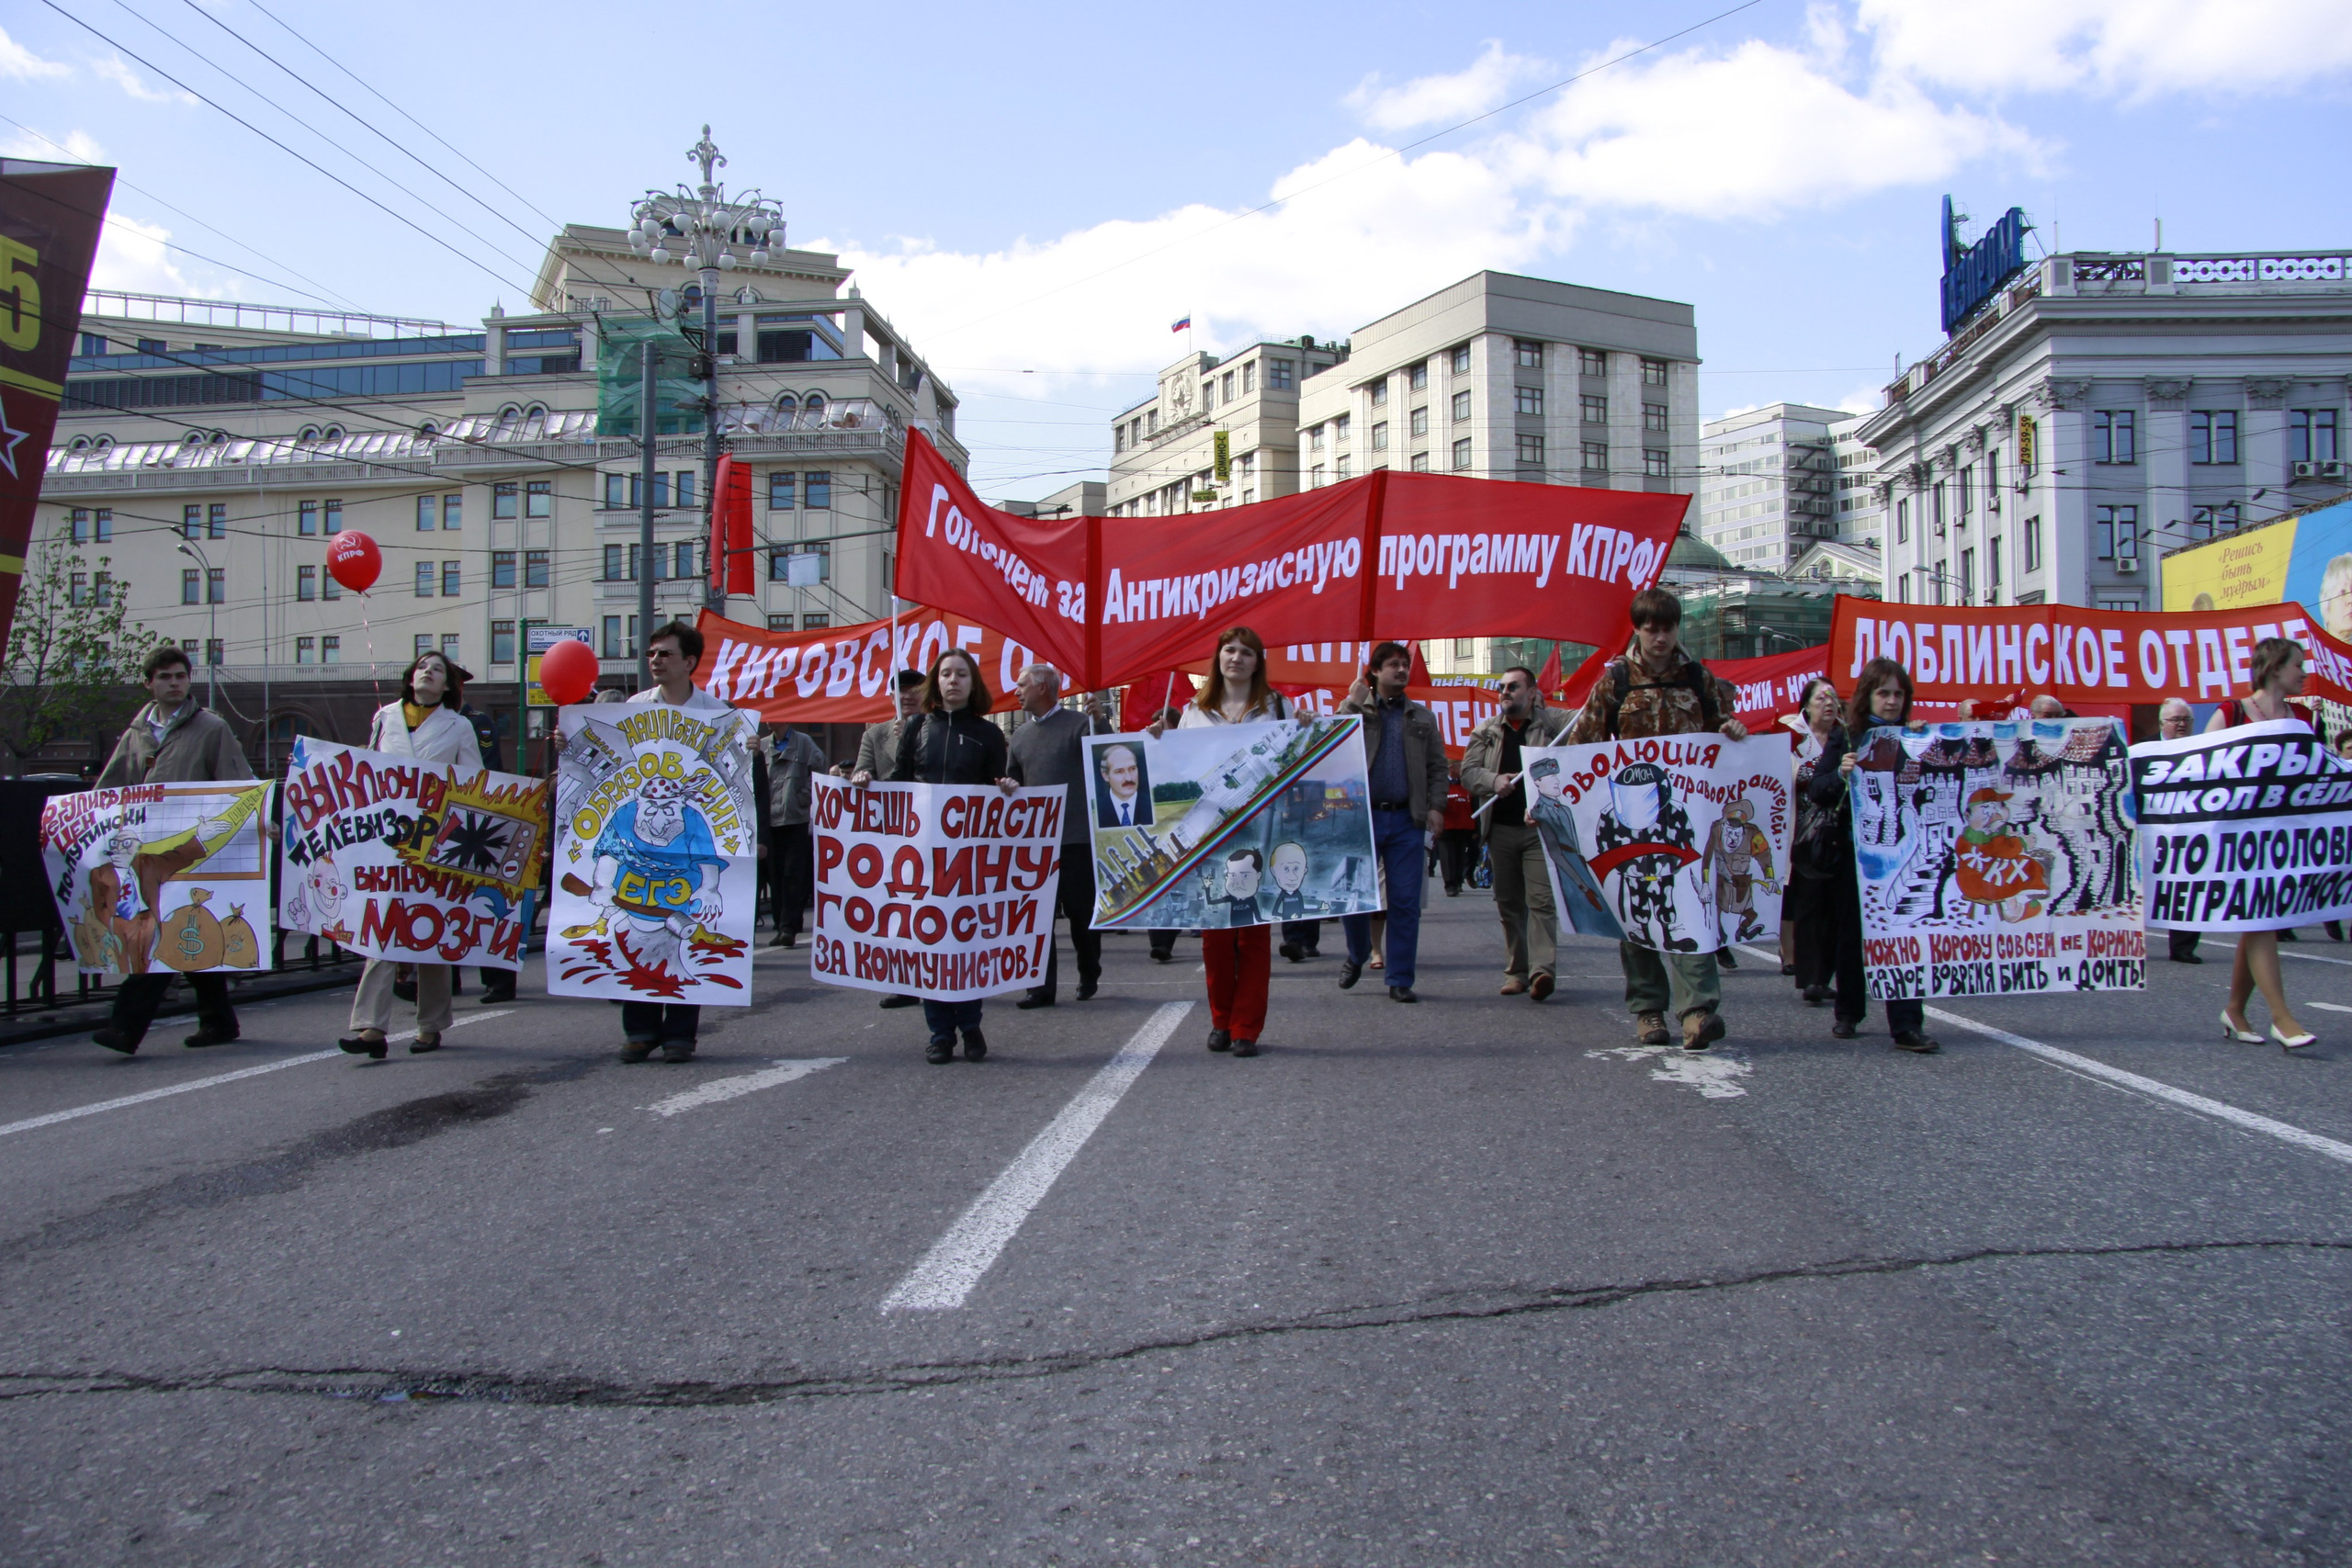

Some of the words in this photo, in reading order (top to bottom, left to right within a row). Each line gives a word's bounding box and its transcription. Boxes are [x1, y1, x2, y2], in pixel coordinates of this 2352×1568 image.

[1217, 436, 1228, 477] ДОМИНО-С
[2021, 416, 2030, 464] 739-59-59
[337, 549, 365, 562] КПРФ
[1056, 581, 1085, 624] за
[1102, 536, 1361, 621] Антикризисную
[1378, 533, 1560, 591] программу
[1566, 523, 1667, 591] КПРФ!
[2222, 563, 2252, 581] быть
[1850, 616, 2128, 688] ЛЮБЛИНСКОЕ
[584, 728, 623, 766] ШКОЛА
[616, 709, 716, 752] НАЦПРОЕКТ
[287, 750, 447, 830] ВЫКЛЮЧИ
[1563, 739, 1721, 805] ЭВОЛЮЦИЯ
[814, 782, 921, 838] ХОЧЕШЬ
[941, 795, 1062, 839] СПАСТИ
[2143, 785, 2259, 815] ШКОЛ
[2258, 784, 2286, 808] В
[2153, 833, 2209, 874] ЭТО
[2215, 826, 2352, 873] ПОГОЛОВ
[355, 865, 475, 904] ВКЛЮЧИ
[618, 872, 692, 906] ЕГЭ
[817, 889, 1037, 944] ГОЛОСУЙ
[815, 934, 850, 976] ЗА
[854, 934, 1046, 991] КОММУНИСТОВ!
[1863, 936, 1921, 966] МОЖНО
[1928, 933, 1992, 964] КОРОВУ
[1996, 932, 2056, 959] СОВСЕМ
[2061, 934, 2083, 951] НЕ
[2086, 930, 2145, 958] КОРМИТЬ
[1931, 962, 1996, 995] ВОВРЕМЯ
[1999, 961, 2050, 992] БИТЬ
[2074, 959, 2145, 990] ДОИТЬ!
